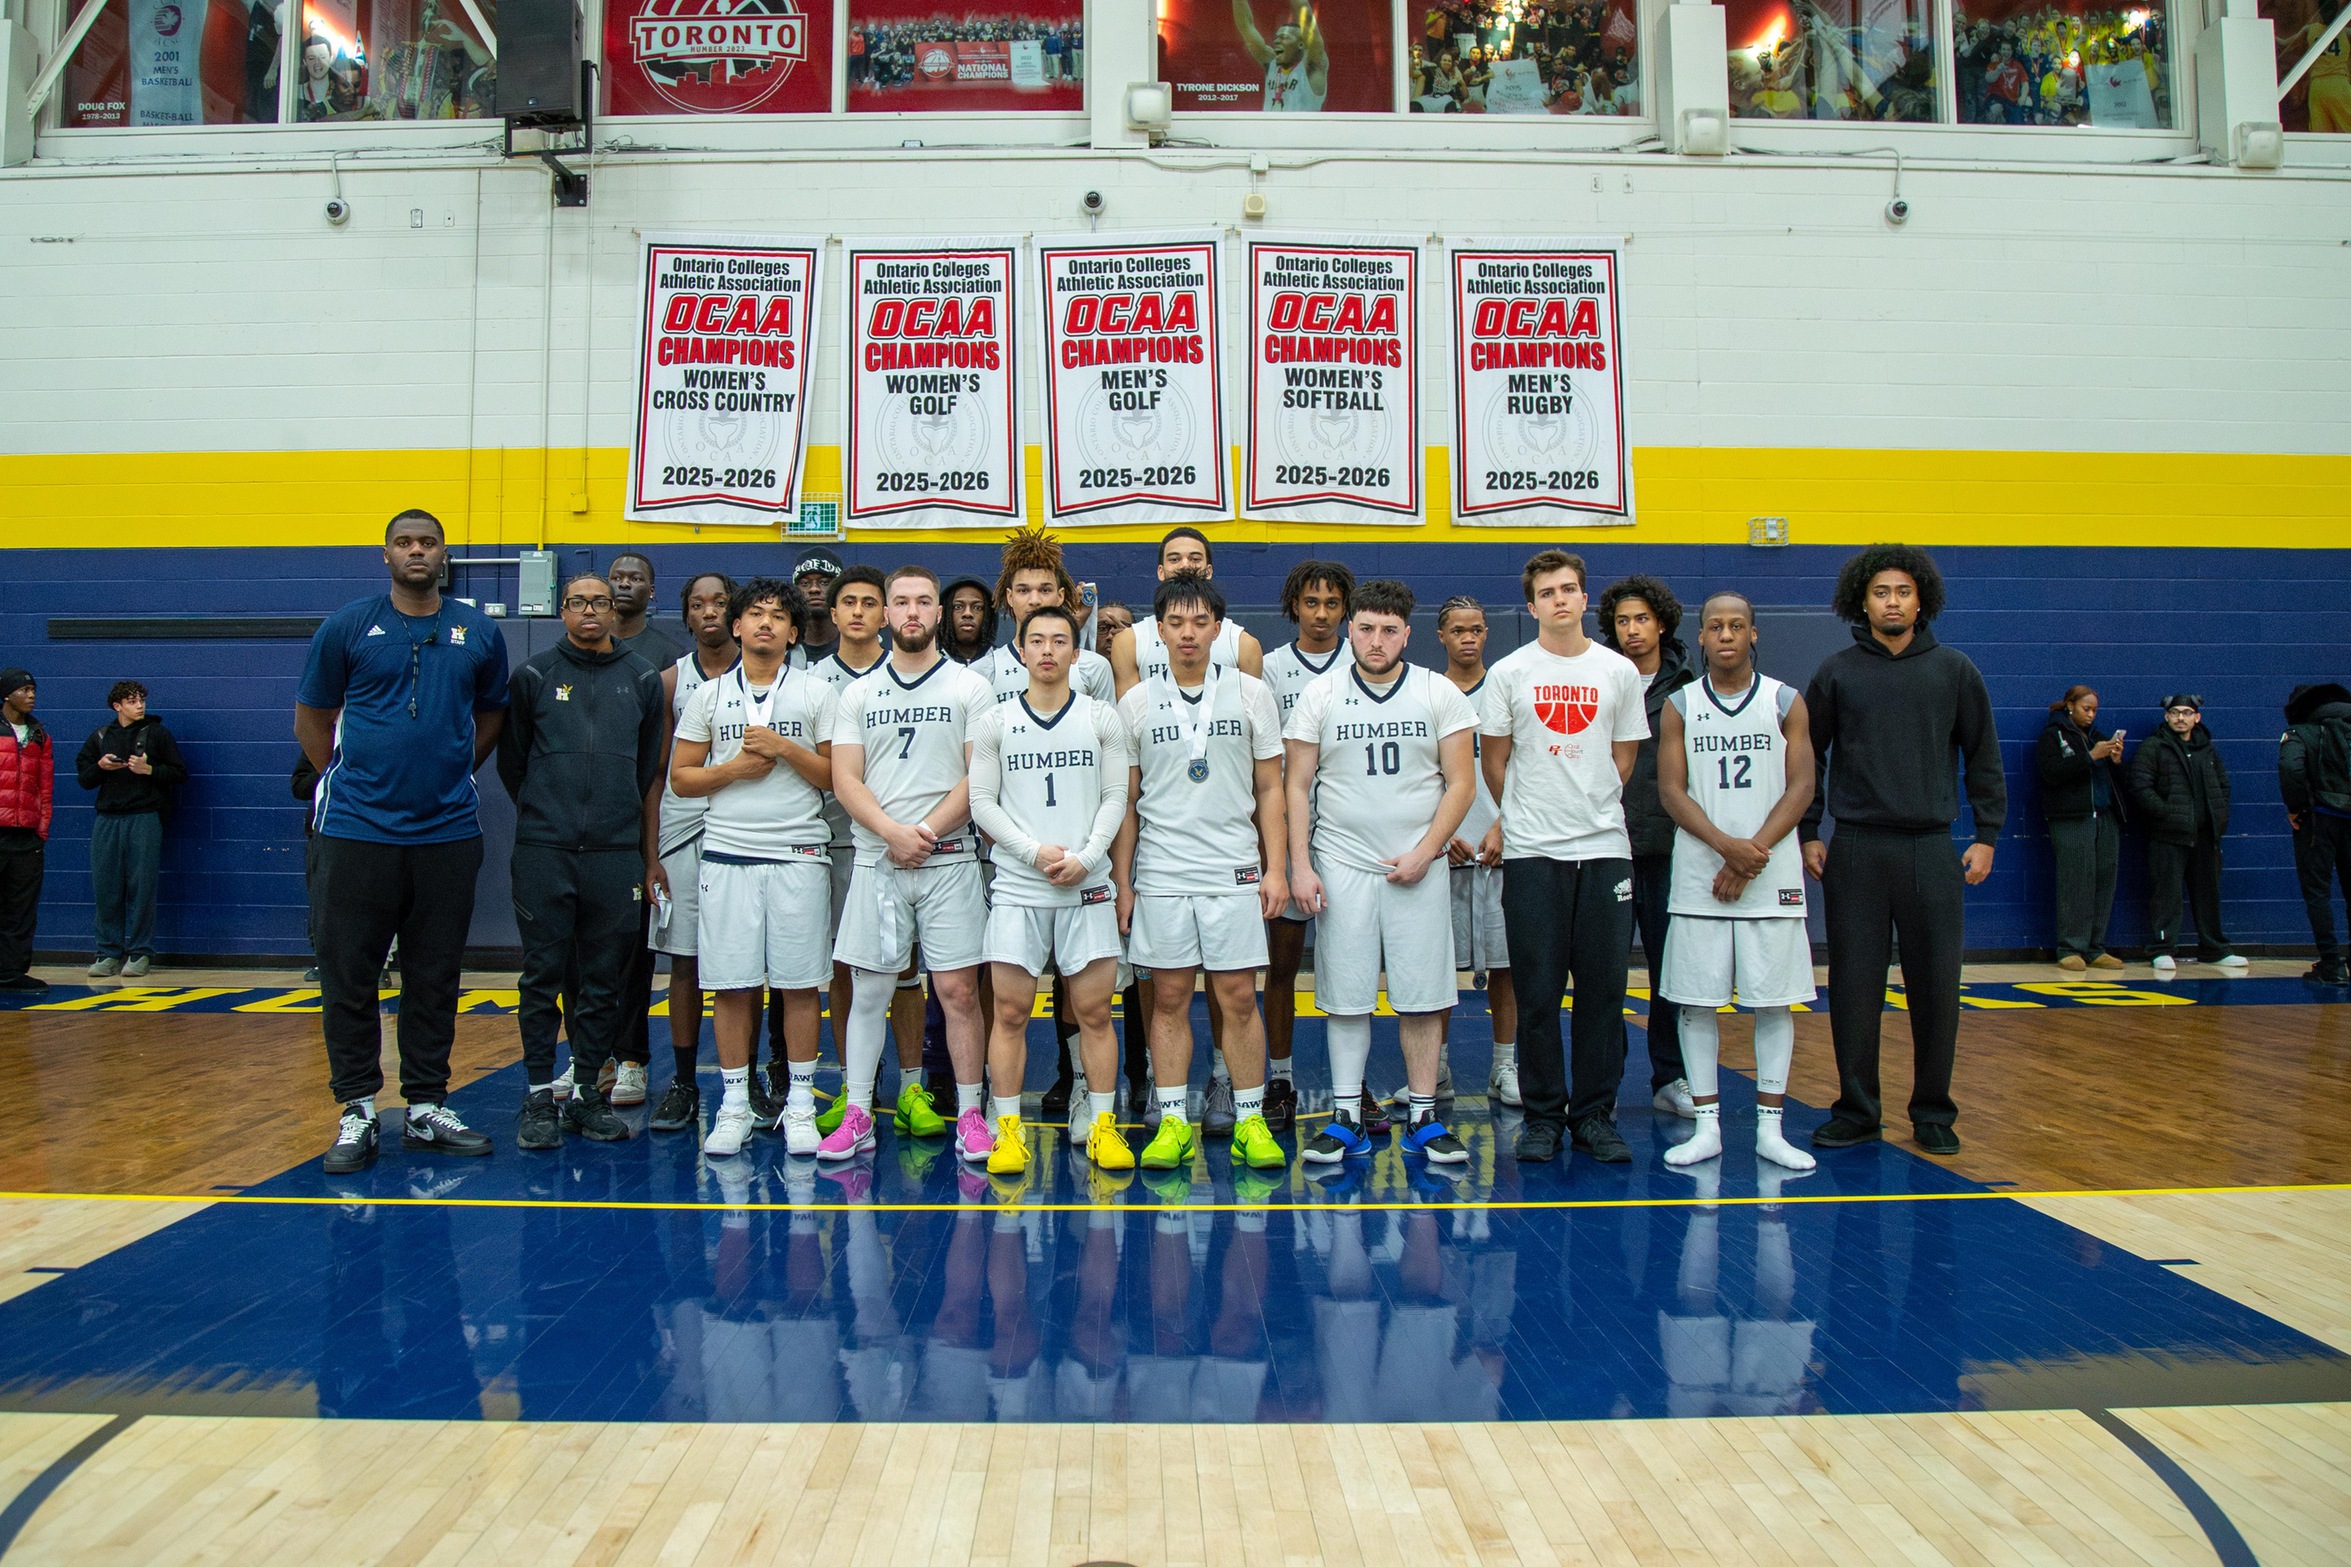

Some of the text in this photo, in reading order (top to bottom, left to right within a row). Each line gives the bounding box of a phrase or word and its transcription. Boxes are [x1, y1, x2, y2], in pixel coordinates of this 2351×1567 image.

[641, 24, 796, 51] TORONTO
[154, 51, 180, 62] 2001
[153, 66, 179, 75] MEN'S
[957, 63, 1009, 72] NATIONAL
[957, 71, 1009, 79] CHAMPIONS
[1176, 83, 1215, 92] TYRONE
[1217, 83, 1259, 92] DICKSON
[78, 102, 126, 111] DOUG FOX
[673, 257, 790, 277] Ontario Colleges
[876, 261, 990, 279] Ontario Colleges
[1068, 257, 1191, 276] Ontario Colleges
[1276, 255, 1393, 275] Ontario Colleges
[1478, 262, 1593, 279] Ontario Colleges
[660, 274, 801, 292] Athletic Association
[864, 277, 1002, 295] Athletic Association
[1057, 273, 1203, 292] Athletic Association
[1263, 273, 1404, 291] Athletic Association
[1467, 277, 1605, 295] Athletic Association
[662, 294, 793, 338] OCAA
[867, 296, 996, 340] OCAA
[1063, 290, 1200, 337] OCAA
[1267, 292, 1398, 336] OCAA
[1472, 297, 1601, 340] OCAA
[658, 337, 795, 370] CHAMPIONS
[865, 341, 1000, 372] CHAMPIONS
[1062, 335, 1203, 370] CHAMPIONS
[1265, 334, 1402, 369] CHAMPIONS
[1471, 341, 1606, 372] CHAMPIONS
[684, 369, 766, 391] WOMEN'S
[885, 373, 980, 394] WOMEN'S
[1101, 368, 1168, 390] MEN'S
[1284, 368, 1383, 390] WOMEN'S
[1508, 373, 1572, 394] MEN'S
[653, 390, 796, 412] CROSS COUNTRY
[910, 395, 957, 415] GOLF
[1109, 391, 1161, 411] GOLF
[1283, 389, 1384, 411] SOFTBALL
[1508, 395, 1573, 415] RUGBY
[662, 466, 776, 488] 2025-2026
[876, 471, 990, 492] 2025-2026
[1079, 465, 1196, 488] 2025-2026
[1276, 465, 1390, 487] 2025-2026
[1485, 470, 1600, 490] 2025-2026
[1534, 685, 1599, 703] TORONTO
[866, 706, 952, 729] HUMBER
[720, 721, 802, 742] HUER
[1152, 720, 1243, 745] HUBER
[1336, 721, 1428, 742] HUMBER
[898, 727, 916, 760] 7
[1693, 734, 1772, 753] HUMBER
[1007, 750, 1094, 771] HUMBER
[1365, 742, 1400, 776] 10
[1718, 755, 1752, 789] 12
[1044, 772, 1057, 807] 1
